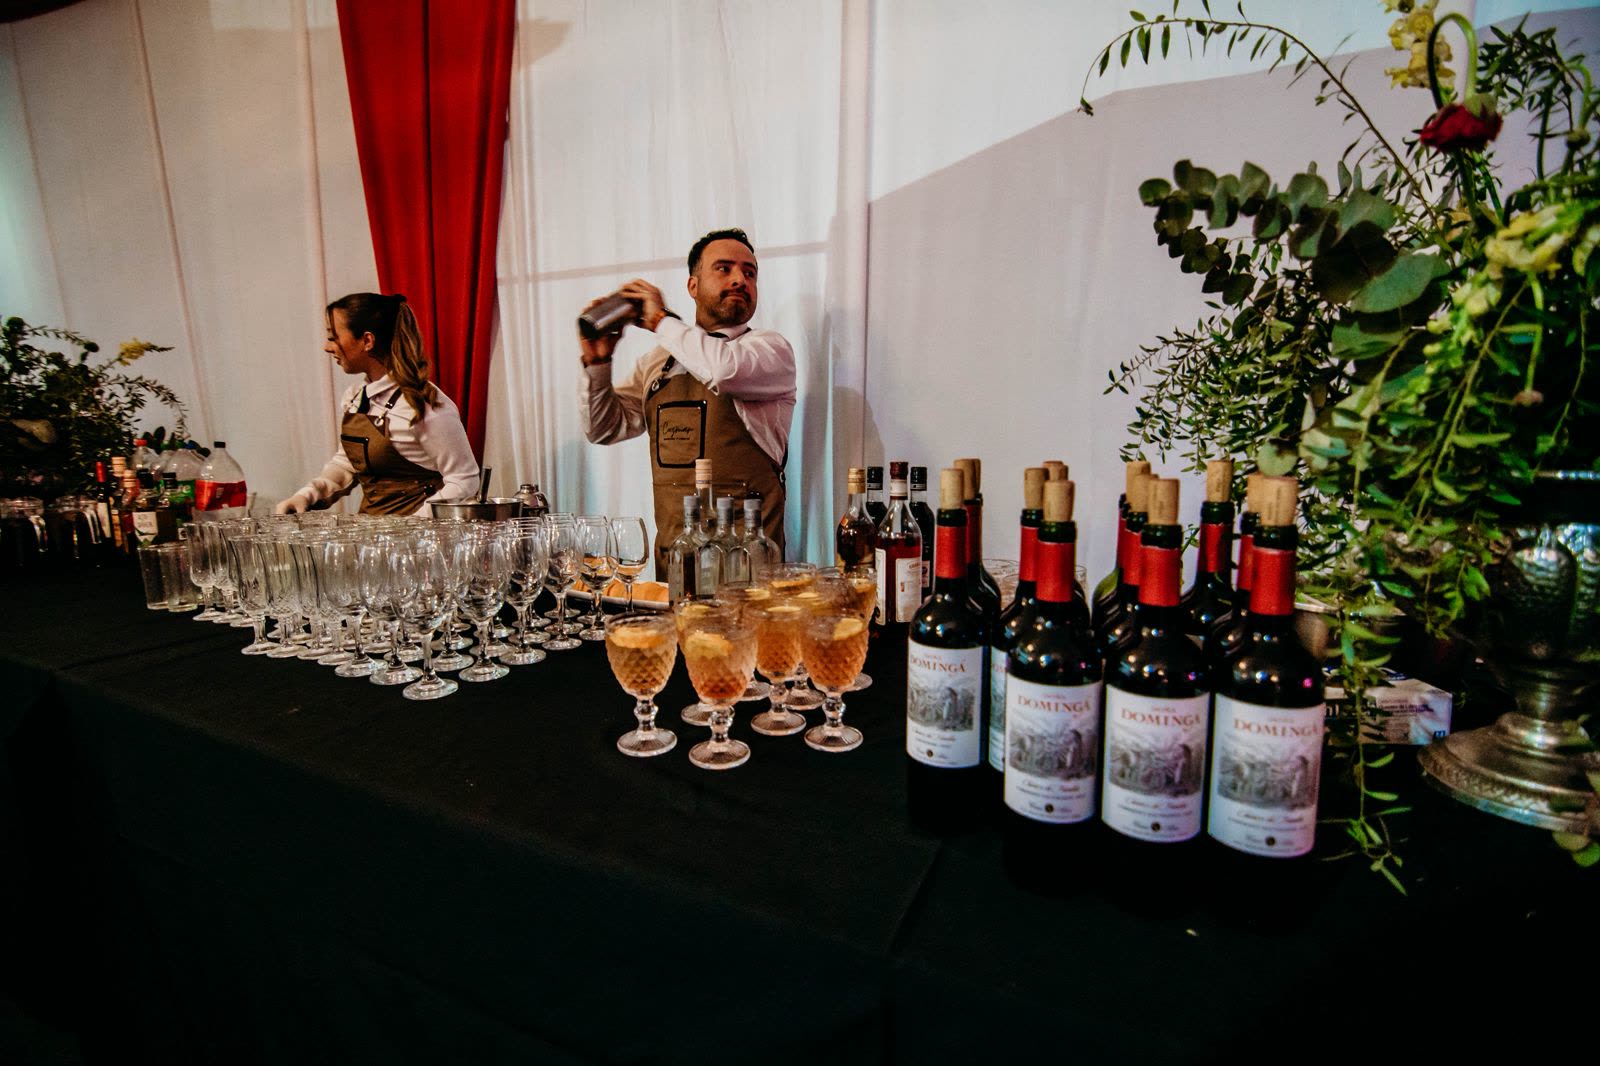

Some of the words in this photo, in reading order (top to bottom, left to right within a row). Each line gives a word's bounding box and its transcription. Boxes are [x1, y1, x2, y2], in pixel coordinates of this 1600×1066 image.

[910, 656, 966, 673] DOMINGA
[1018, 695, 1091, 713] DOMINGA
[1120, 707, 1201, 727] DOMINGA
[1233, 718, 1321, 737] DOMINGA
